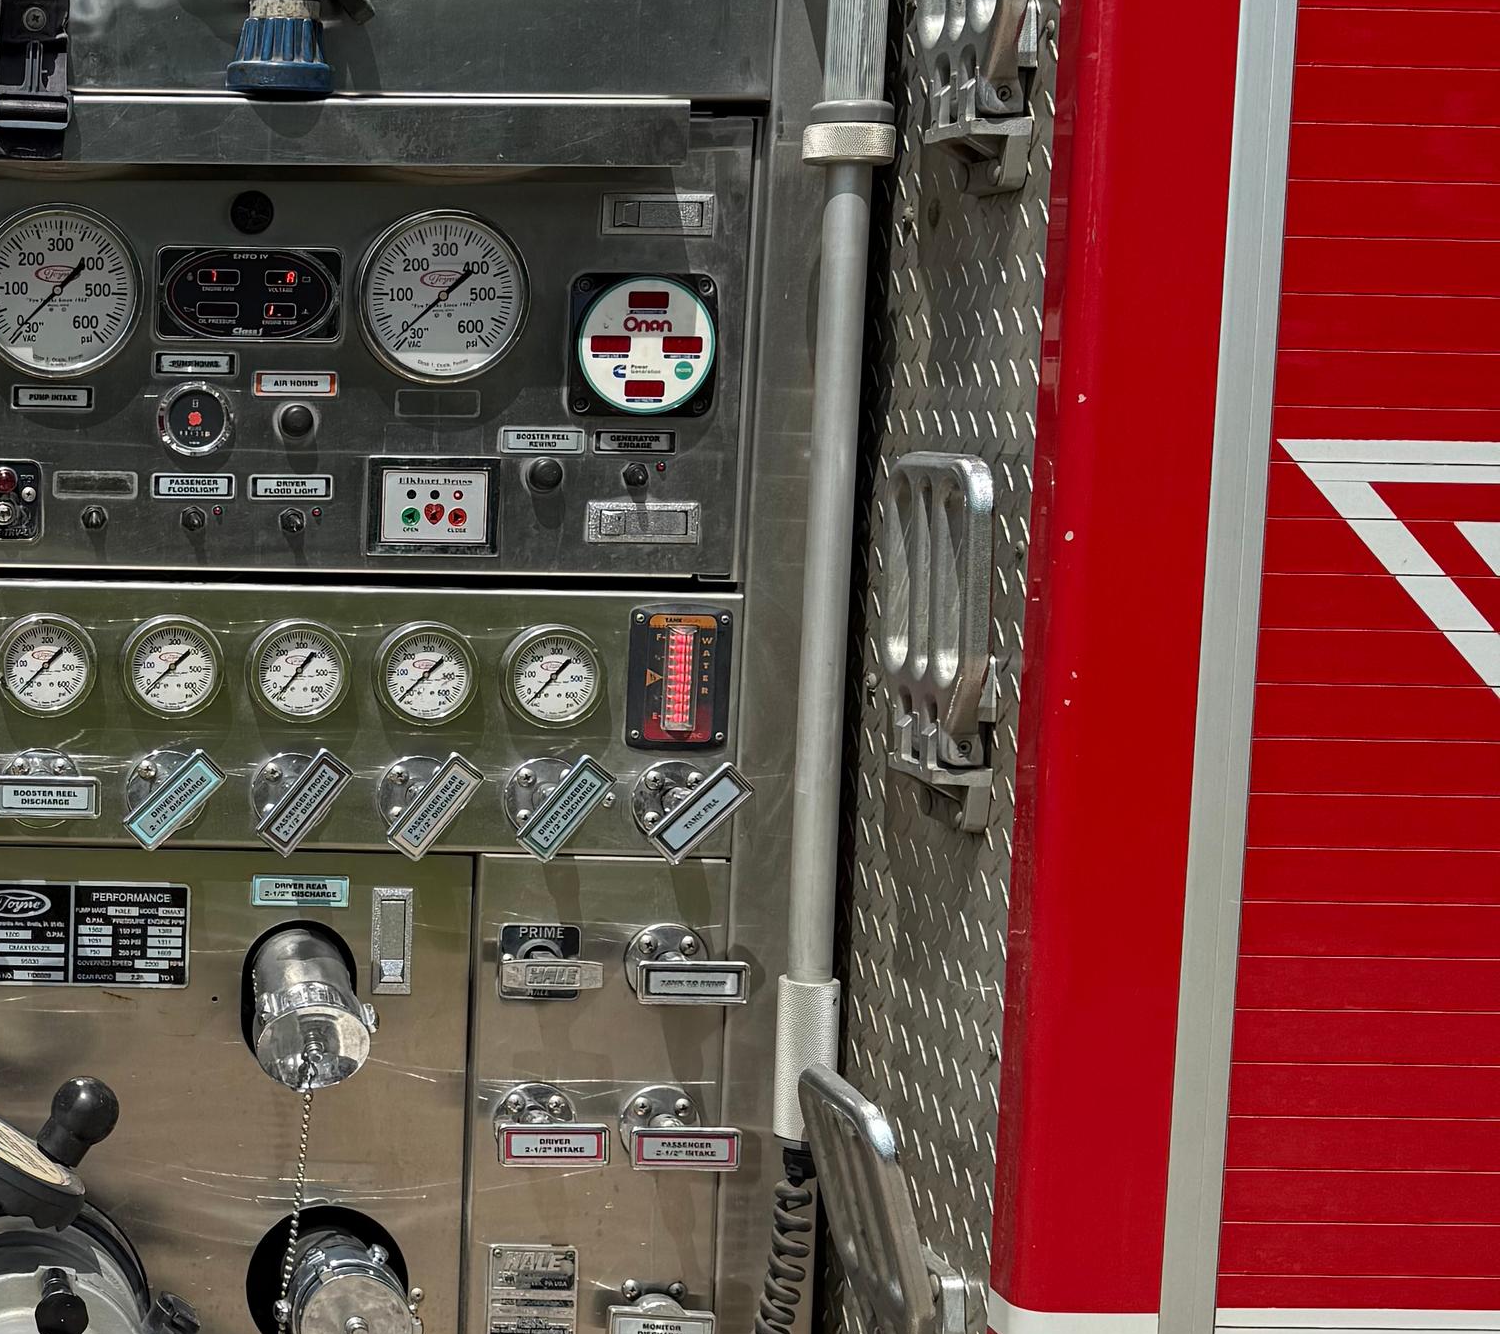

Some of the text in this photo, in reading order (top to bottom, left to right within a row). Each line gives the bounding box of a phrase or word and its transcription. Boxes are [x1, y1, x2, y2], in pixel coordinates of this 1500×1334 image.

[47, 237, 74, 252] 300
[432, 243, 458, 257] 300
[18, 251, 45, 266] 200
[402, 258, 430, 272] 200
[462, 261, 489, 275] 400
[4, 281, 28, 295] 100
[85, 283, 111, 297] 500
[389, 287, 413, 302] 100
[470, 287, 496, 302] 500
[73, 316, 99, 329] 600
[458, 320, 484, 333] 600
[623, 316, 673, 333] Onan
[22, 334, 37, 342] VAC
[80, 334, 93, 344] psi
[407, 340, 422, 348] VAC
[465, 339, 478, 349] psi
[28, 393, 50, 401] PUMP
[398, 477, 473, 486] Elkhart Brass
[13, 789, 78, 798] BOOSTER REEL
[151, 777, 194, 819] DRIVER REAR
[169, 776, 207, 814] DISCHARGE
[275, 768, 329, 833] PASSENGER FRONT
[300, 775, 335, 815] DISCHARGE
[432, 778, 466, 819] DISCHARGE
[21, 798, 70, 806] DISCHARGE
[407, 774, 459, 835] PASSENGER REAR
[538, 777, 590, 838] DRIVER HOSEBED
[561, 781, 598, 822] DISCHARGE
[683, 798, 720, 830] TANK FILL
[274, 882, 305, 890] DRIVER
[92, 892, 171, 904] PERFORMANCE
[519, 926, 565, 940] PRIME
[528, 967, 578, 985] HALE
[554, 1146, 585, 1154] INTAKE
[661, 1141, 712, 1149] PASSENGER
[504, 1251, 566, 1271] HALE
[642, 1323, 682, 1332] MONITOR
